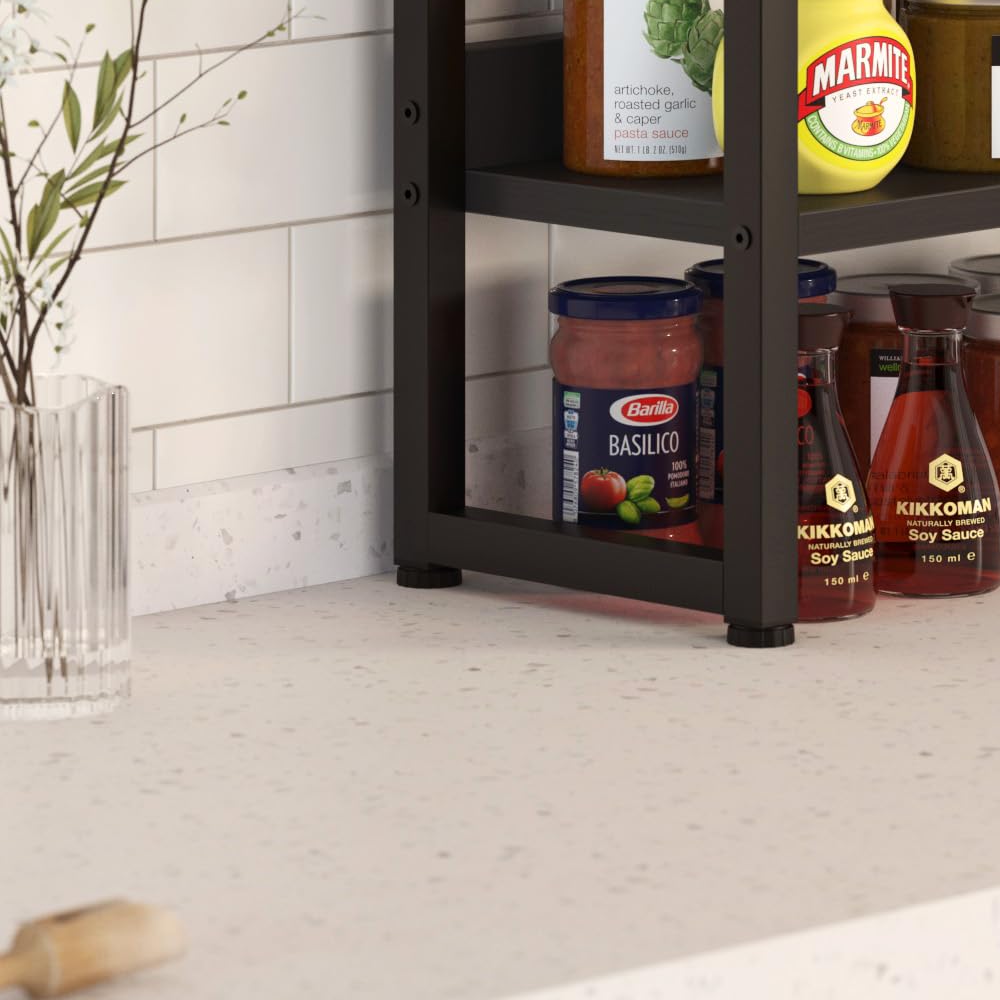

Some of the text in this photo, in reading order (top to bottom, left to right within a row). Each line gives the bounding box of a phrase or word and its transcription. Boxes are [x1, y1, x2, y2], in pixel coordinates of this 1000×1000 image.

[812, 41, 909, 97] MARMITE
[614, 84, 674, 97] artichoke,
[832, 86, 900, 103] YEAST EXTRACT
[614, 97, 697, 112] roasted garlic
[614, 113, 662, 127] & caper
[614, 128, 689, 141] pasta sauce
[807, 115, 837, 151] CONTAINS
[626, 399, 674, 418] Barilla
[608, 430, 680, 457] BASILICO
[671, 459, 688, 471] 100%
[896, 497, 992, 517] KIKKOMAN
[797, 515, 875, 540] KIKKOMAN
[907, 516, 986, 528] NATURALLY BREWED
[808, 535, 874, 551] NATURALLY BREWED
[908, 528, 985, 544] Soy Sauce
[810, 546, 874, 566] Soy Sauce
[921, 554, 943, 563] 150
[947, 553, 961, 563] ml
[824, 577, 844, 587] 150
[847, 574, 859, 584] ml
